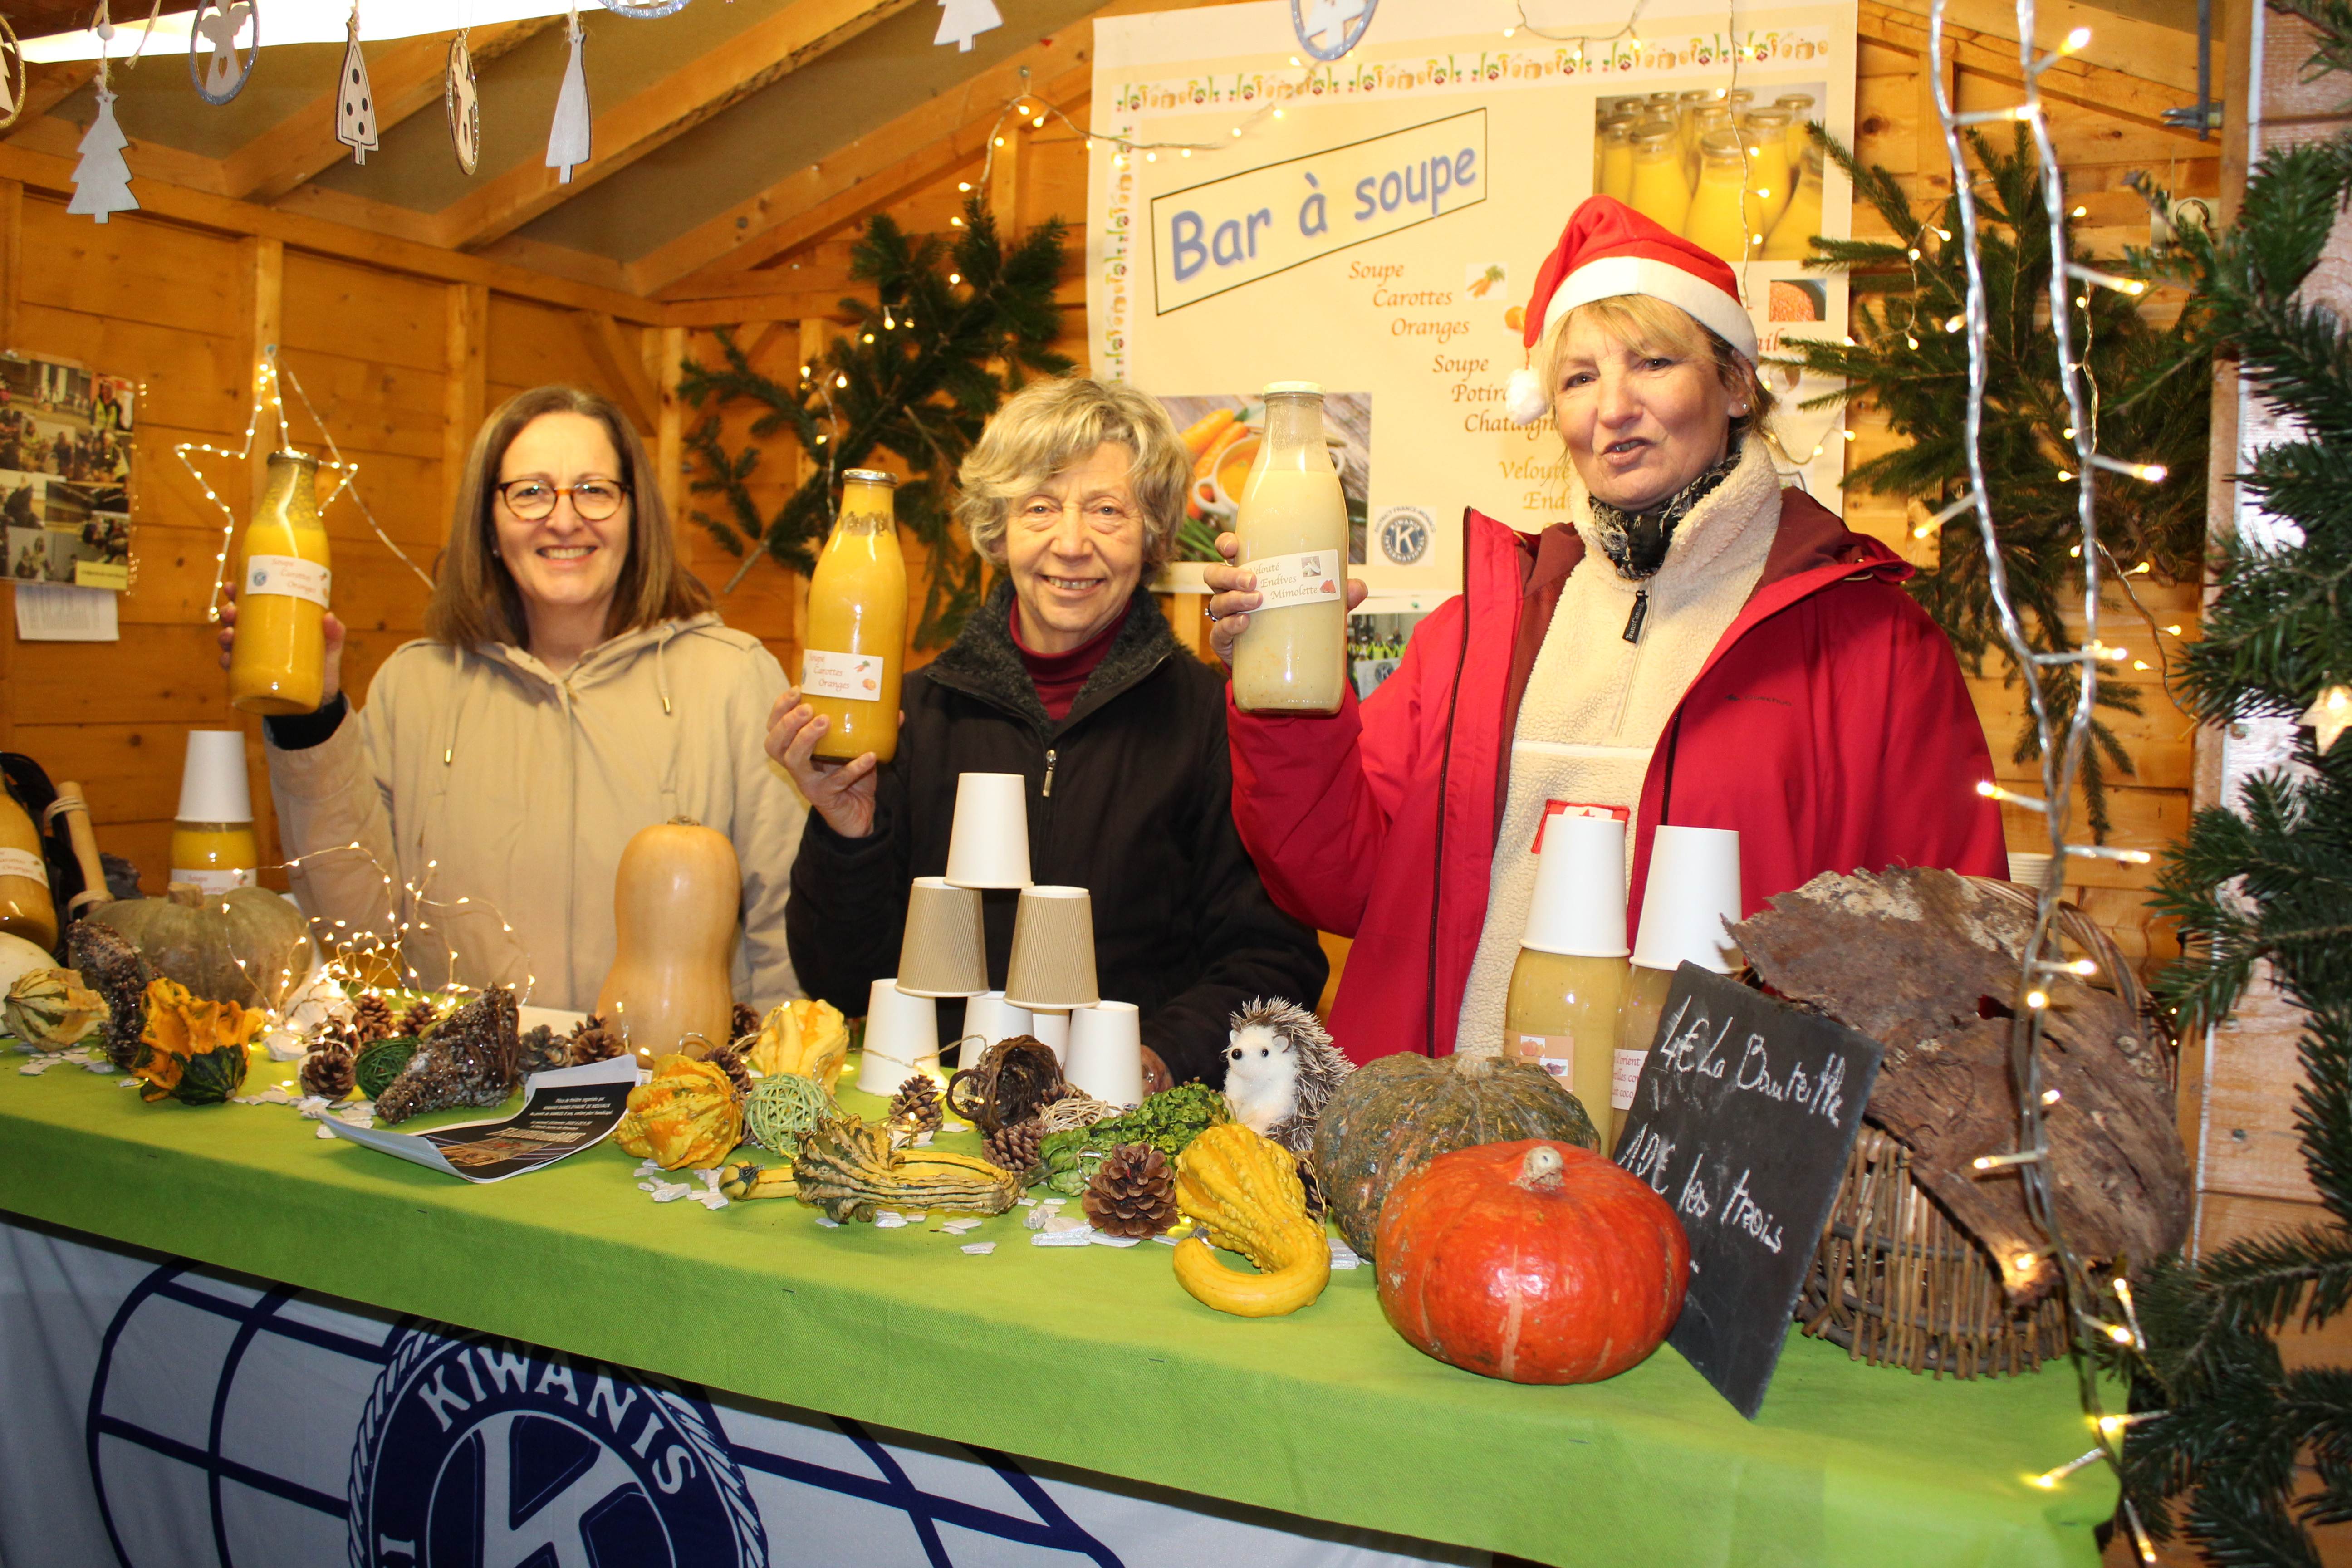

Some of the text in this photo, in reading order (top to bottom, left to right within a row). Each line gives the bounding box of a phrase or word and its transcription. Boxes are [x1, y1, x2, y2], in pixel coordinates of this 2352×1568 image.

[1171, 147, 1476, 282] Bar à soupe
[1348, 261, 1404, 288] Soupe
[1373, 289, 1453, 307] Carottes
[1391, 318, 1470, 344] Oranges
[1432, 354, 1489, 382] Soupe
[1523, 487, 1571, 510] End
[1260, 574, 1297, 588] Endives
[1270, 584, 1318, 600] Mimolette
[814, 666, 843, 676] Carottes
[818, 678, 850, 692] Oranges
[1620, 1090, 1633, 1098] coco
[419, 1341, 696, 1495] KIWANIS
